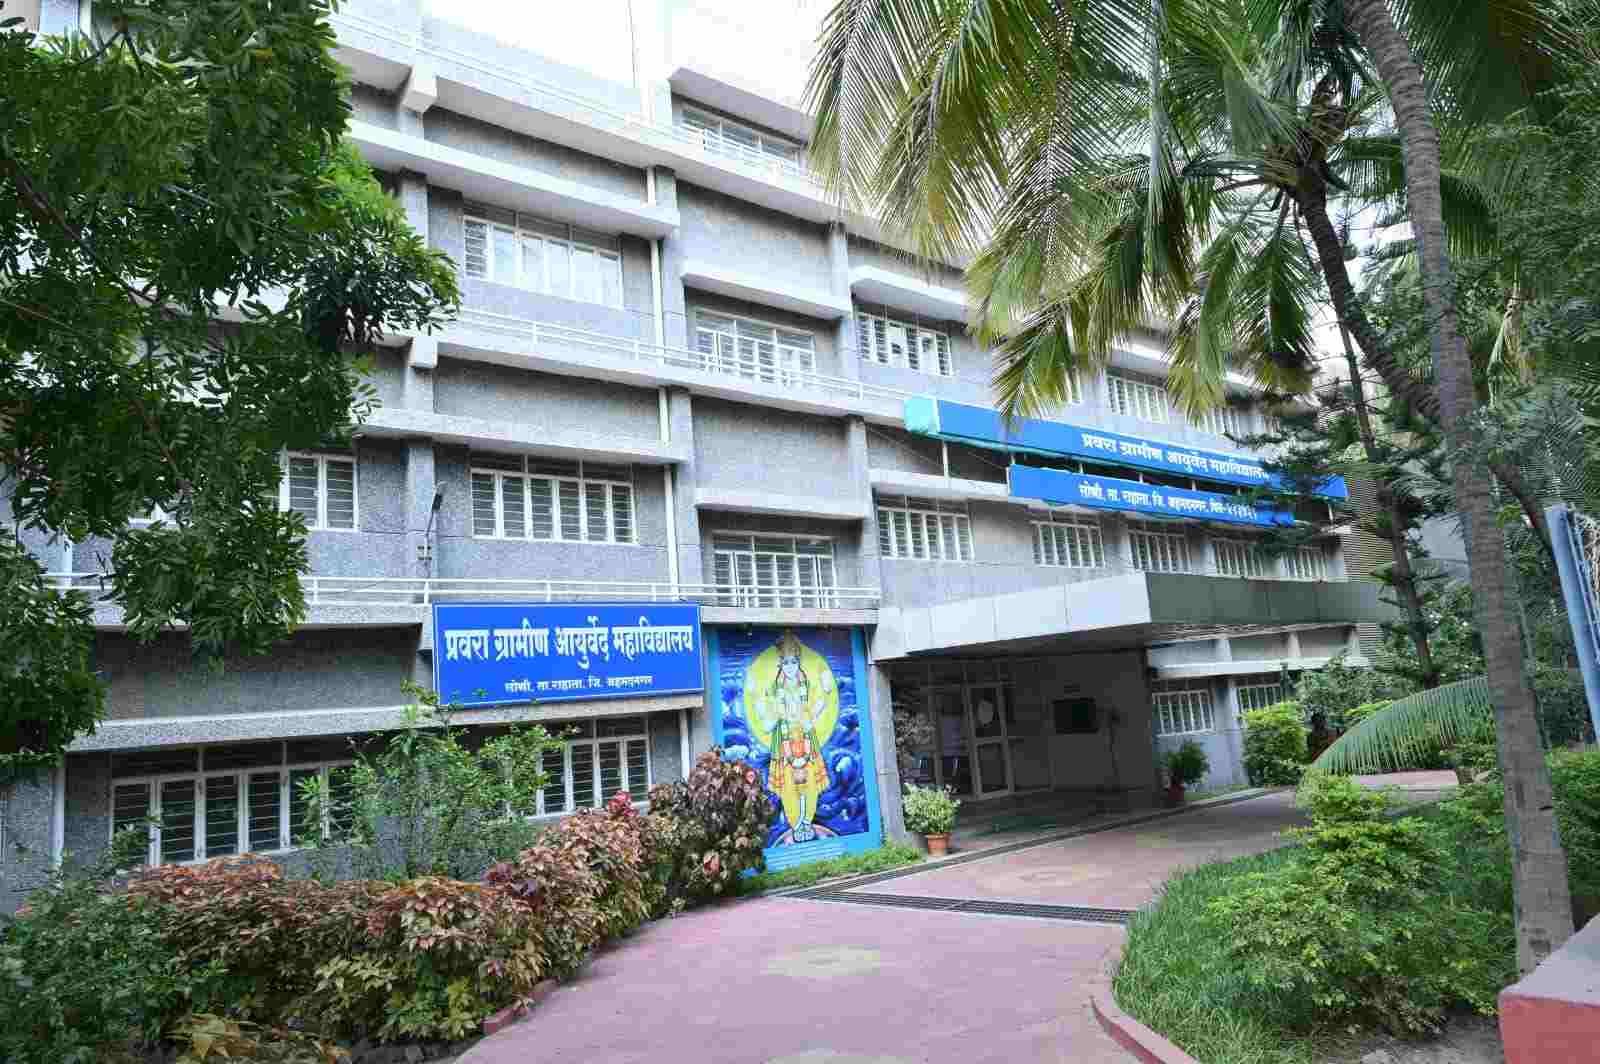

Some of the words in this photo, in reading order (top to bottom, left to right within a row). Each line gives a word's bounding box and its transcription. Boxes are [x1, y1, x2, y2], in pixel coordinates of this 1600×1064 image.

[1081, 432, 1117, 453] प्रवरा
[1119, 440, 1163, 461] ग्रामीण
[1167, 449, 1208, 473] आयुर्वेद
[444, 629, 489, 661] प्रवरा
[493, 617, 549, 662] ग्रामीण
[553, 615, 609, 670] आयुर्वेद
[611, 615, 693, 661] महाविद्यालय
